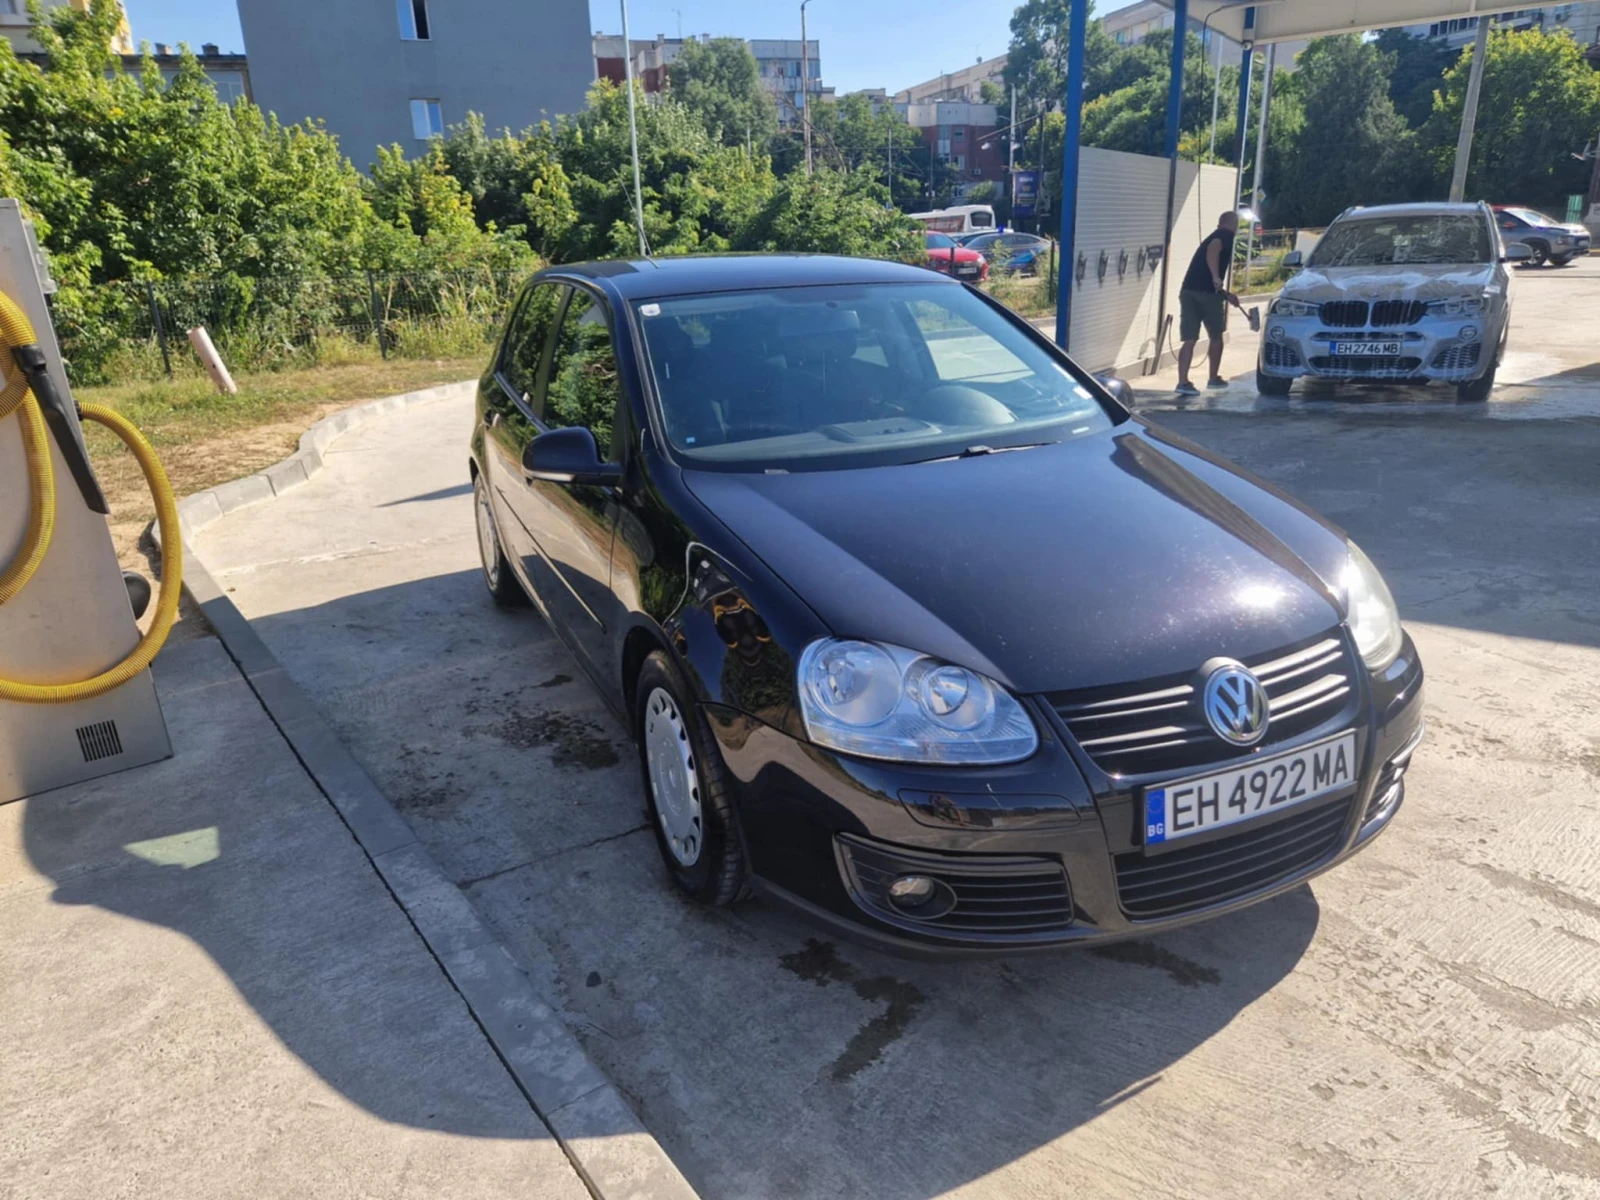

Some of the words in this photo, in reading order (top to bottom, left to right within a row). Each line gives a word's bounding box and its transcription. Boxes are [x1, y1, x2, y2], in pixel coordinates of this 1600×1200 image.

[1337, 343, 1352, 354] EH
[1353, 343, 1381, 354] 2746
[1382, 343, 1398, 354] MB
[1173, 781, 1219, 832] EH
[1228, 758, 1306, 814] 4922
[1312, 743, 1348, 791] MA
[1147, 823, 1164, 837] BG
